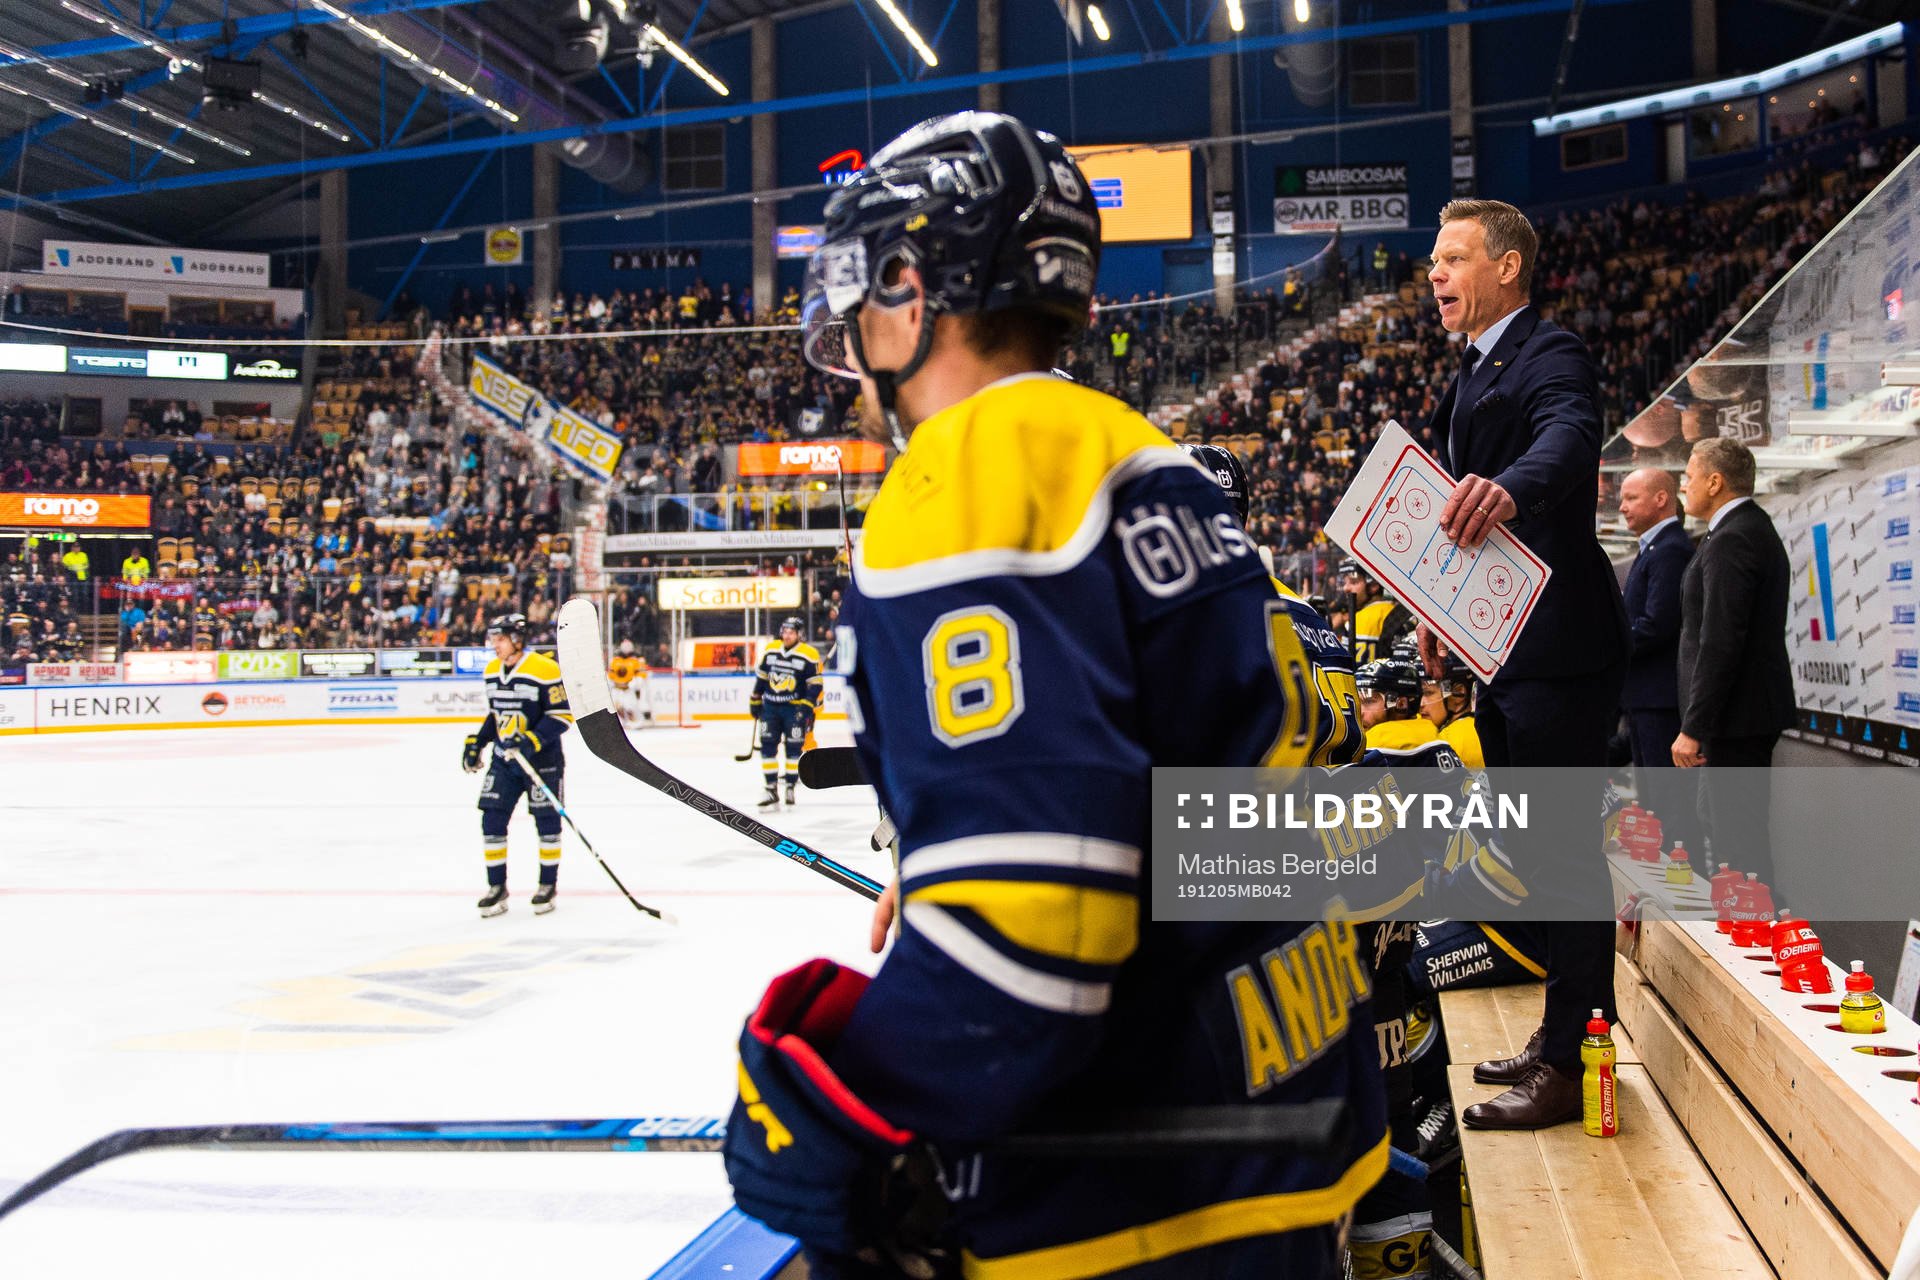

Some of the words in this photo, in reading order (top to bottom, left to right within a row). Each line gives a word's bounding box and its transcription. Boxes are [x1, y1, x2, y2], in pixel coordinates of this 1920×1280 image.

[1306, 167, 1406, 184] SAMBOOSAK
[1301, 201, 1345, 219] MR.
[1351, 199, 1405, 219] BBQ
[613, 252, 697, 269] PRIMA
[553, 412, 615, 465] TIFO
[781, 445, 842, 464] ramo
[24, 498, 99, 515] ramo
[683, 583, 777, 605] Scandic
[922, 604, 1025, 749] 8
[1801, 661, 1850, 686] ADDBRAND
[51, 696, 161, 717] HENRIX
[234, 696, 285, 704] BETONG
[662, 779, 779, 846] NEXUS
[791, 854, 812, 867] PRO
[1426, 941, 1488, 973] SHERWIN
[1792, 942, 1820, 955] ENERVIT
[1429, 957, 1494, 989] WILLIAMS
[1603, 1077, 1612, 1113] ENERVIT
